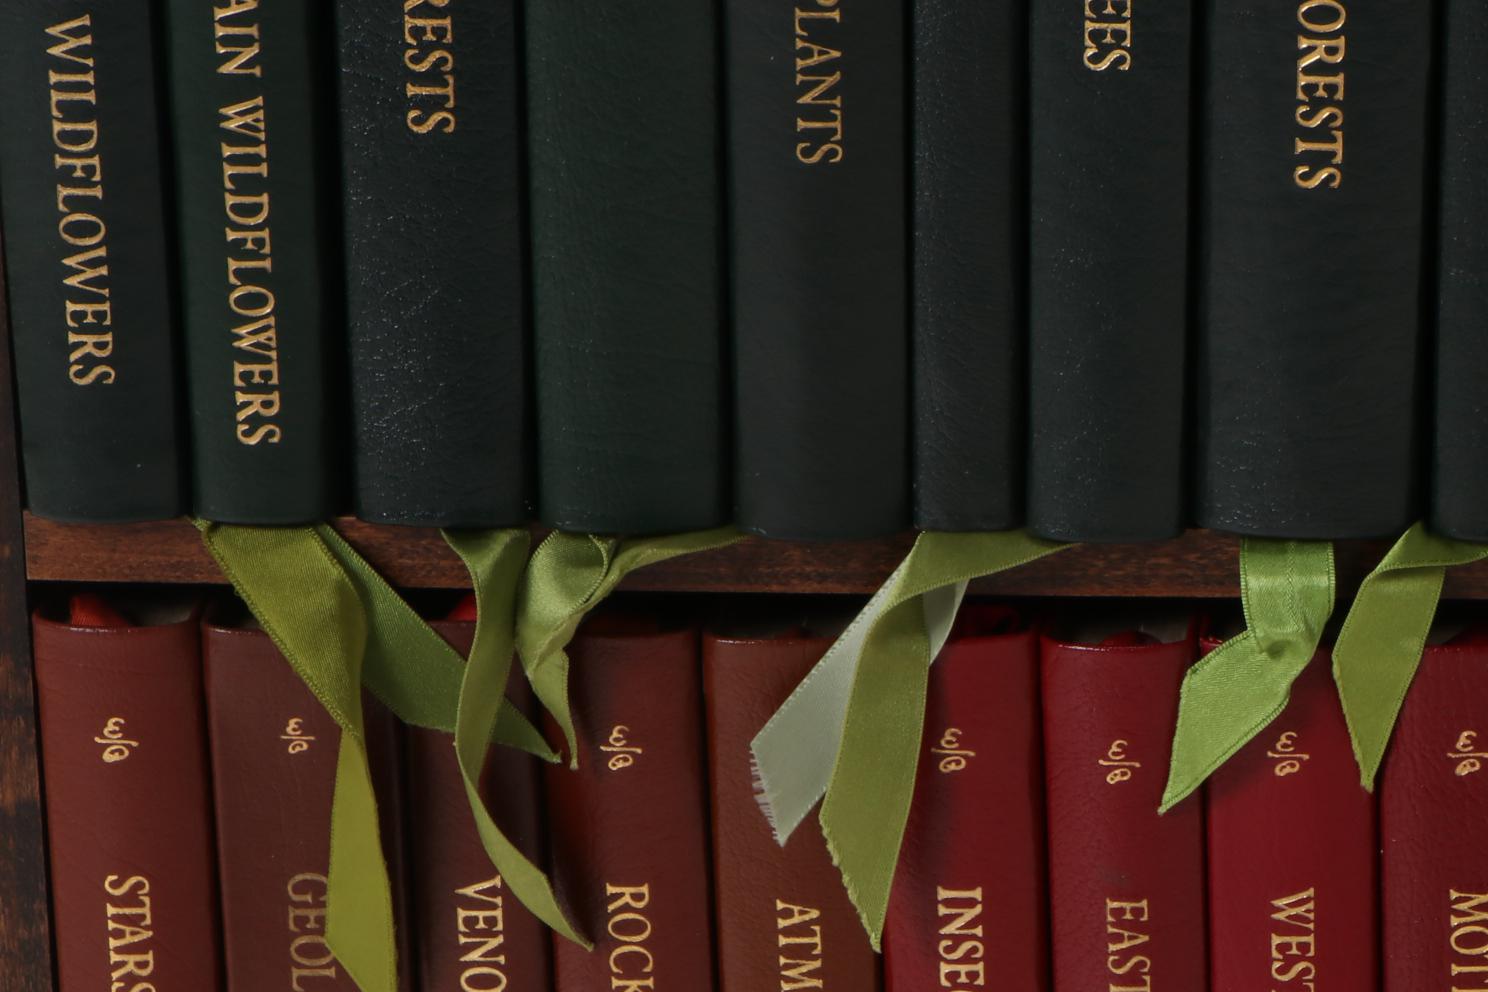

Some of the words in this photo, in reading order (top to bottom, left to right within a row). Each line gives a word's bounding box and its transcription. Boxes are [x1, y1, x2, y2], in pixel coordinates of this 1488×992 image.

[44, 13, 116, 386] WILDFLOWERS
[794, 0, 843, 164] LANTS
[1293, 0, 1346, 190] ORESTS
[218, 95, 281, 446] WILDFLOWERS
